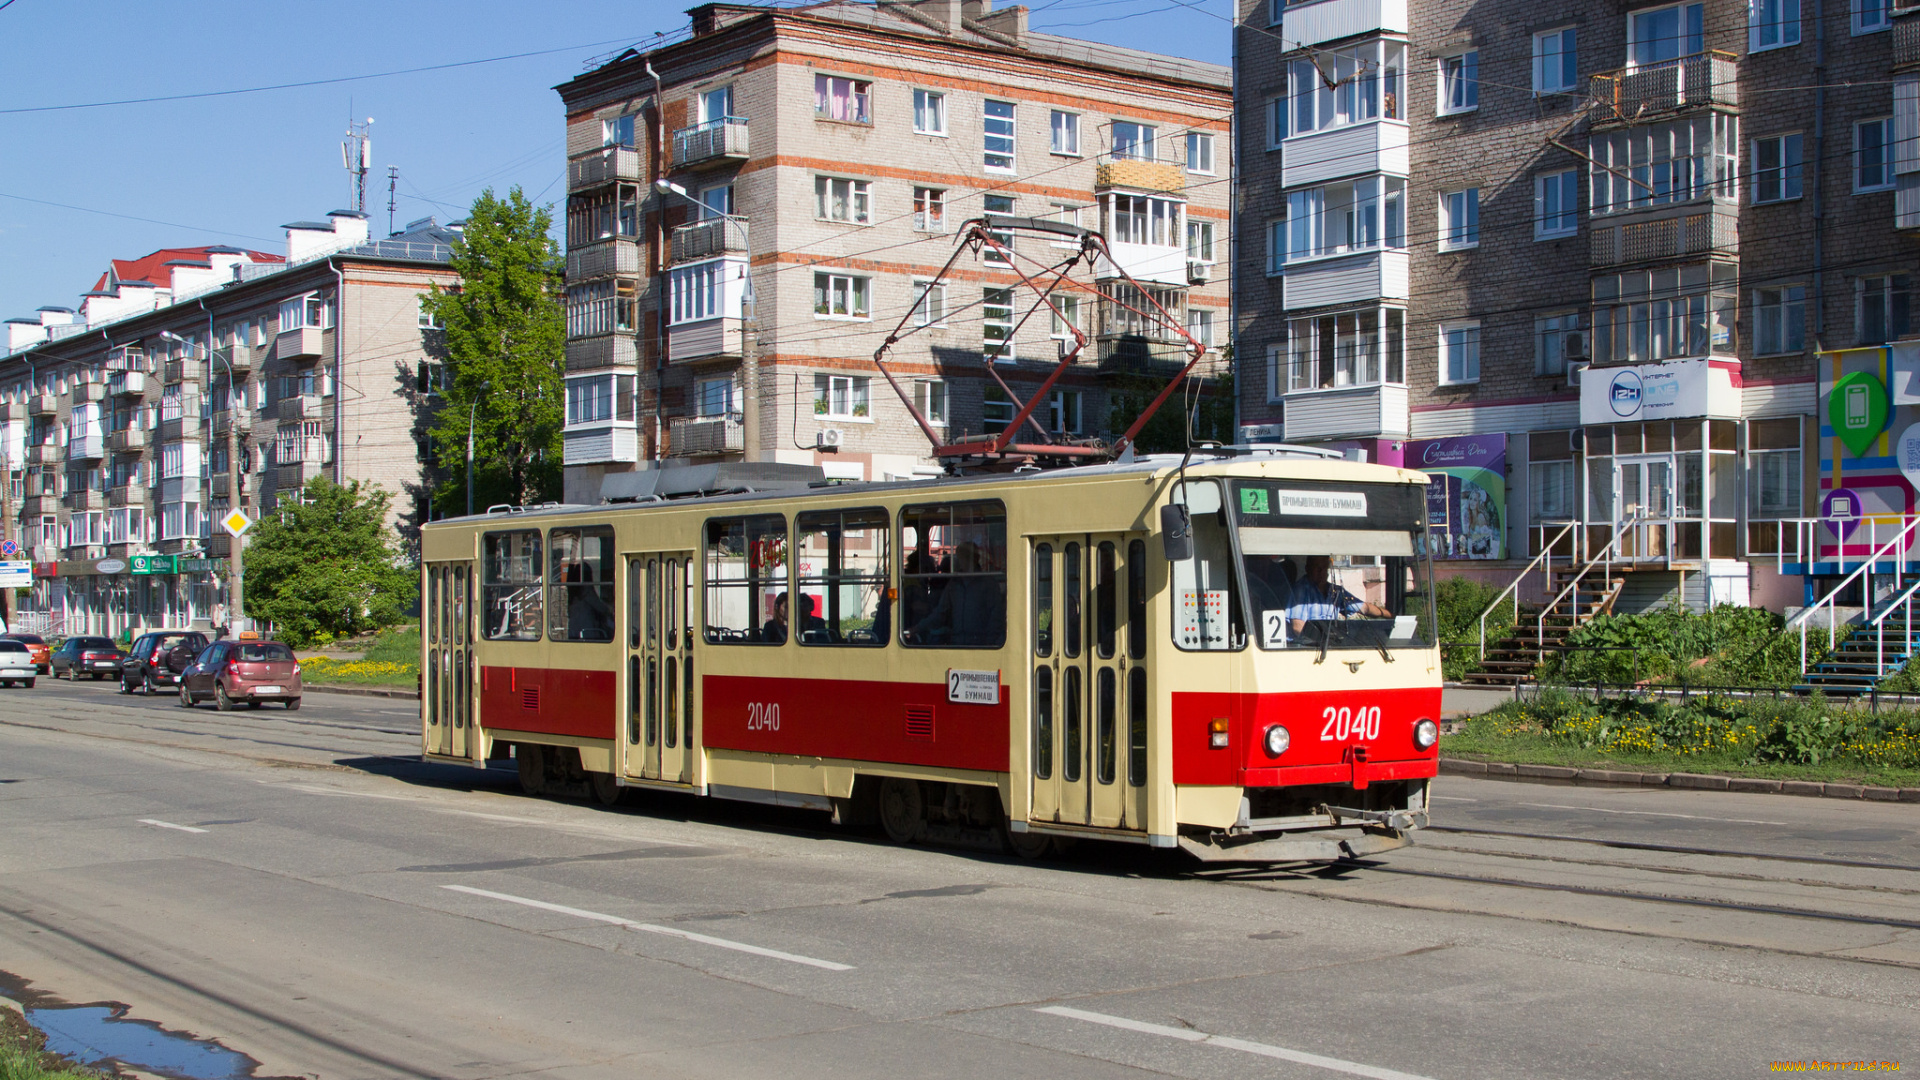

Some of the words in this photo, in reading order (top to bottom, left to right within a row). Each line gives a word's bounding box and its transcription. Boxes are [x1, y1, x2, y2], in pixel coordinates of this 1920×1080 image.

[1249, 491, 1260, 511] 2
[750, 540, 782, 568] 2040
[1268, 615, 1282, 643] 2
[951, 673, 959, 698] 2
[748, 702, 780, 731] 2040
[1320, 706, 1381, 741] 2040
